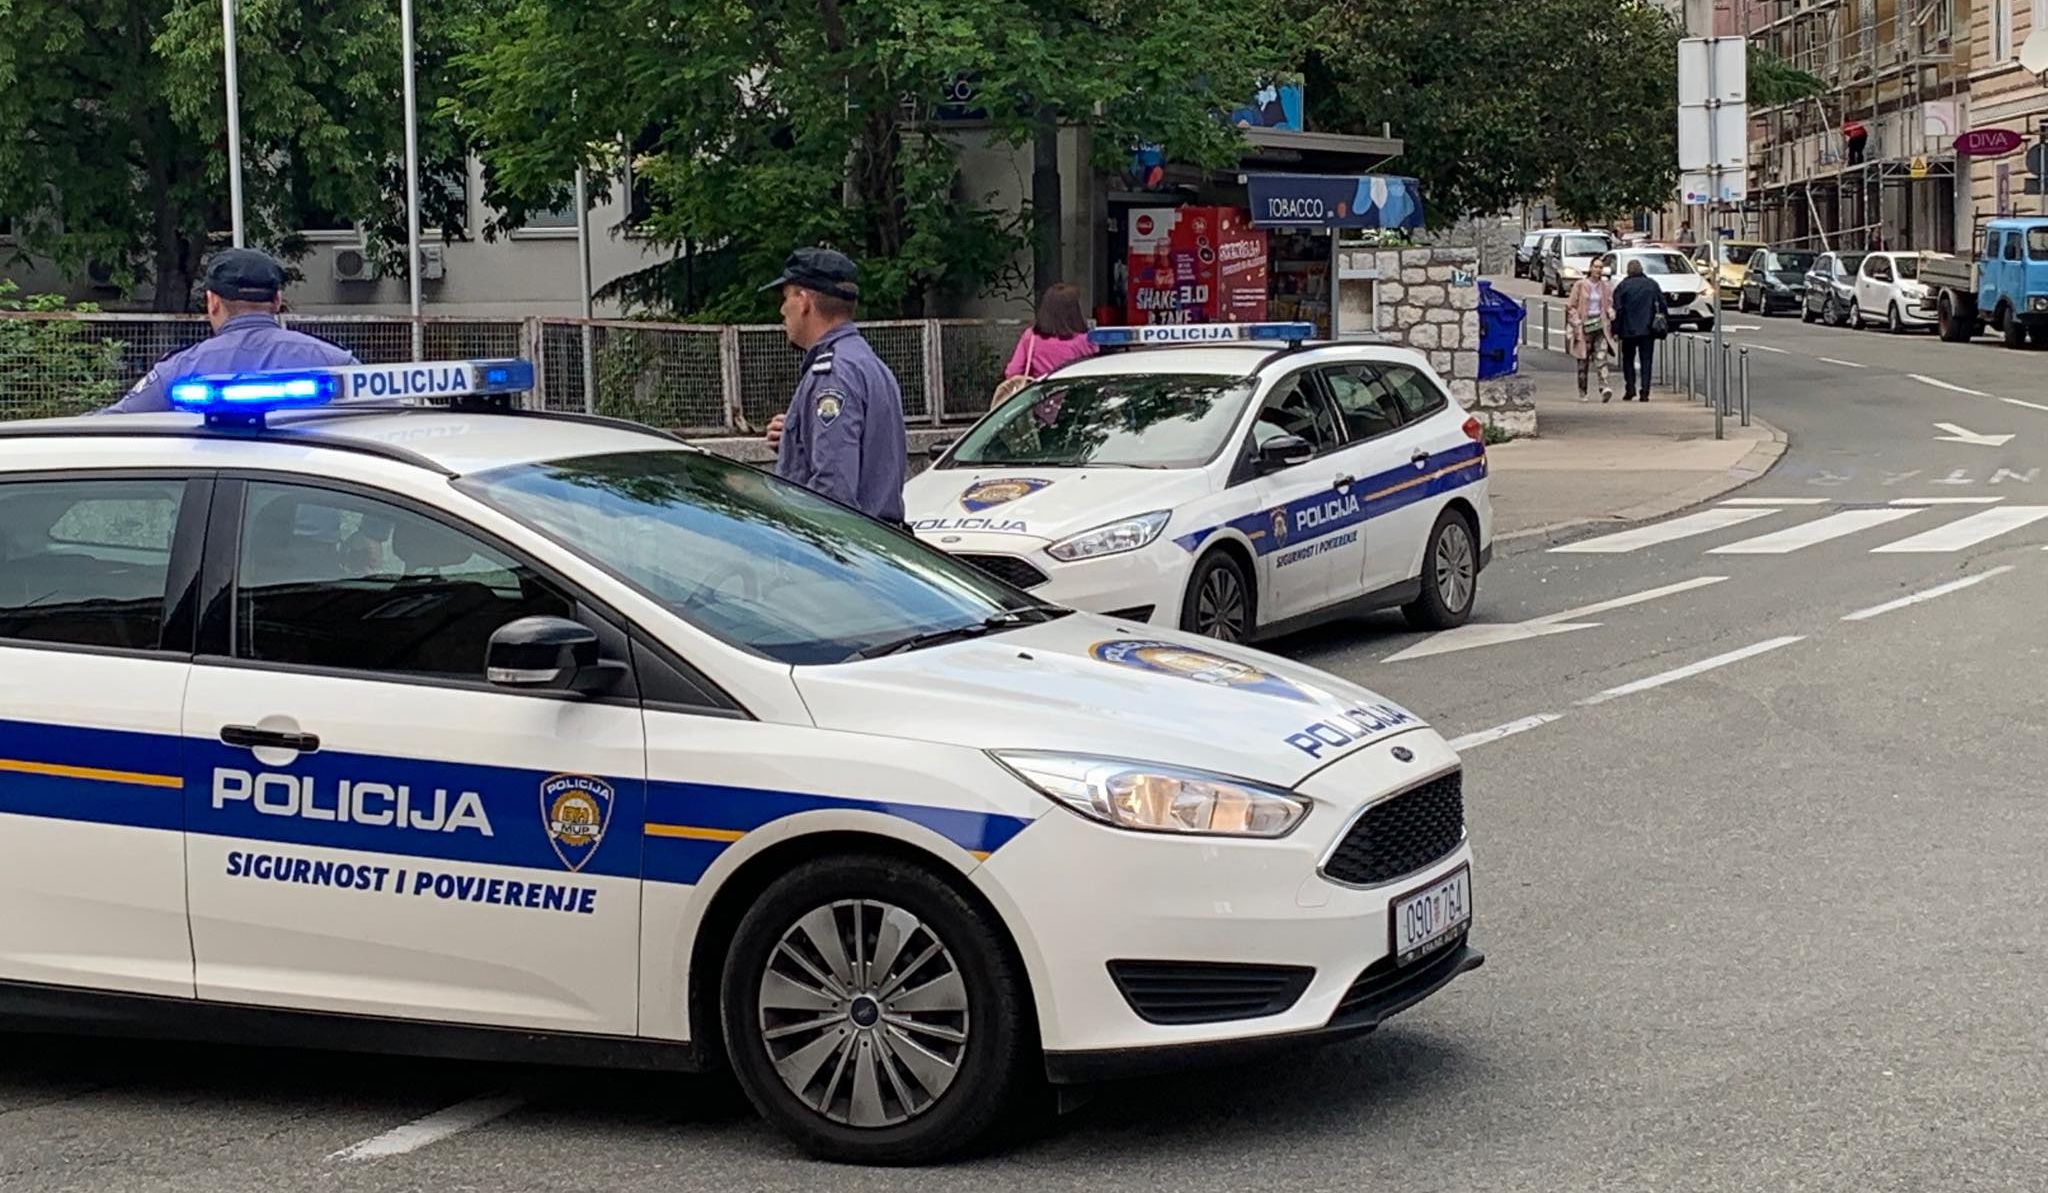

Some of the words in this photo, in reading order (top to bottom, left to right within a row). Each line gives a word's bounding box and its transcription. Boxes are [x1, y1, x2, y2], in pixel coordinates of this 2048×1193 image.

[1969, 132, 2008, 148] DIVA
[1268, 198, 1324, 218] TOBACCO
[1136, 287, 1178, 310] SHAKE
[1159, 309, 1193, 325] TAKE
[1143, 327, 1233, 341] POLICIJA
[352, 367, 466, 397] POLICIJA
[1296, 494, 1360, 532] POLICIJA
[1284, 704, 1415, 758] POLICIJA
[547, 779, 610, 800] POLICIJA
[212, 768, 493, 836] POLICIJA
[561, 824, 591, 834] MUP
[226, 851, 390, 892] SIGURNOST
[394, 869, 407, 894] I
[413, 872, 598, 915] POVJERENJE
[1406, 896, 1432, 943] 090
[1441, 879, 1462, 926] 764
